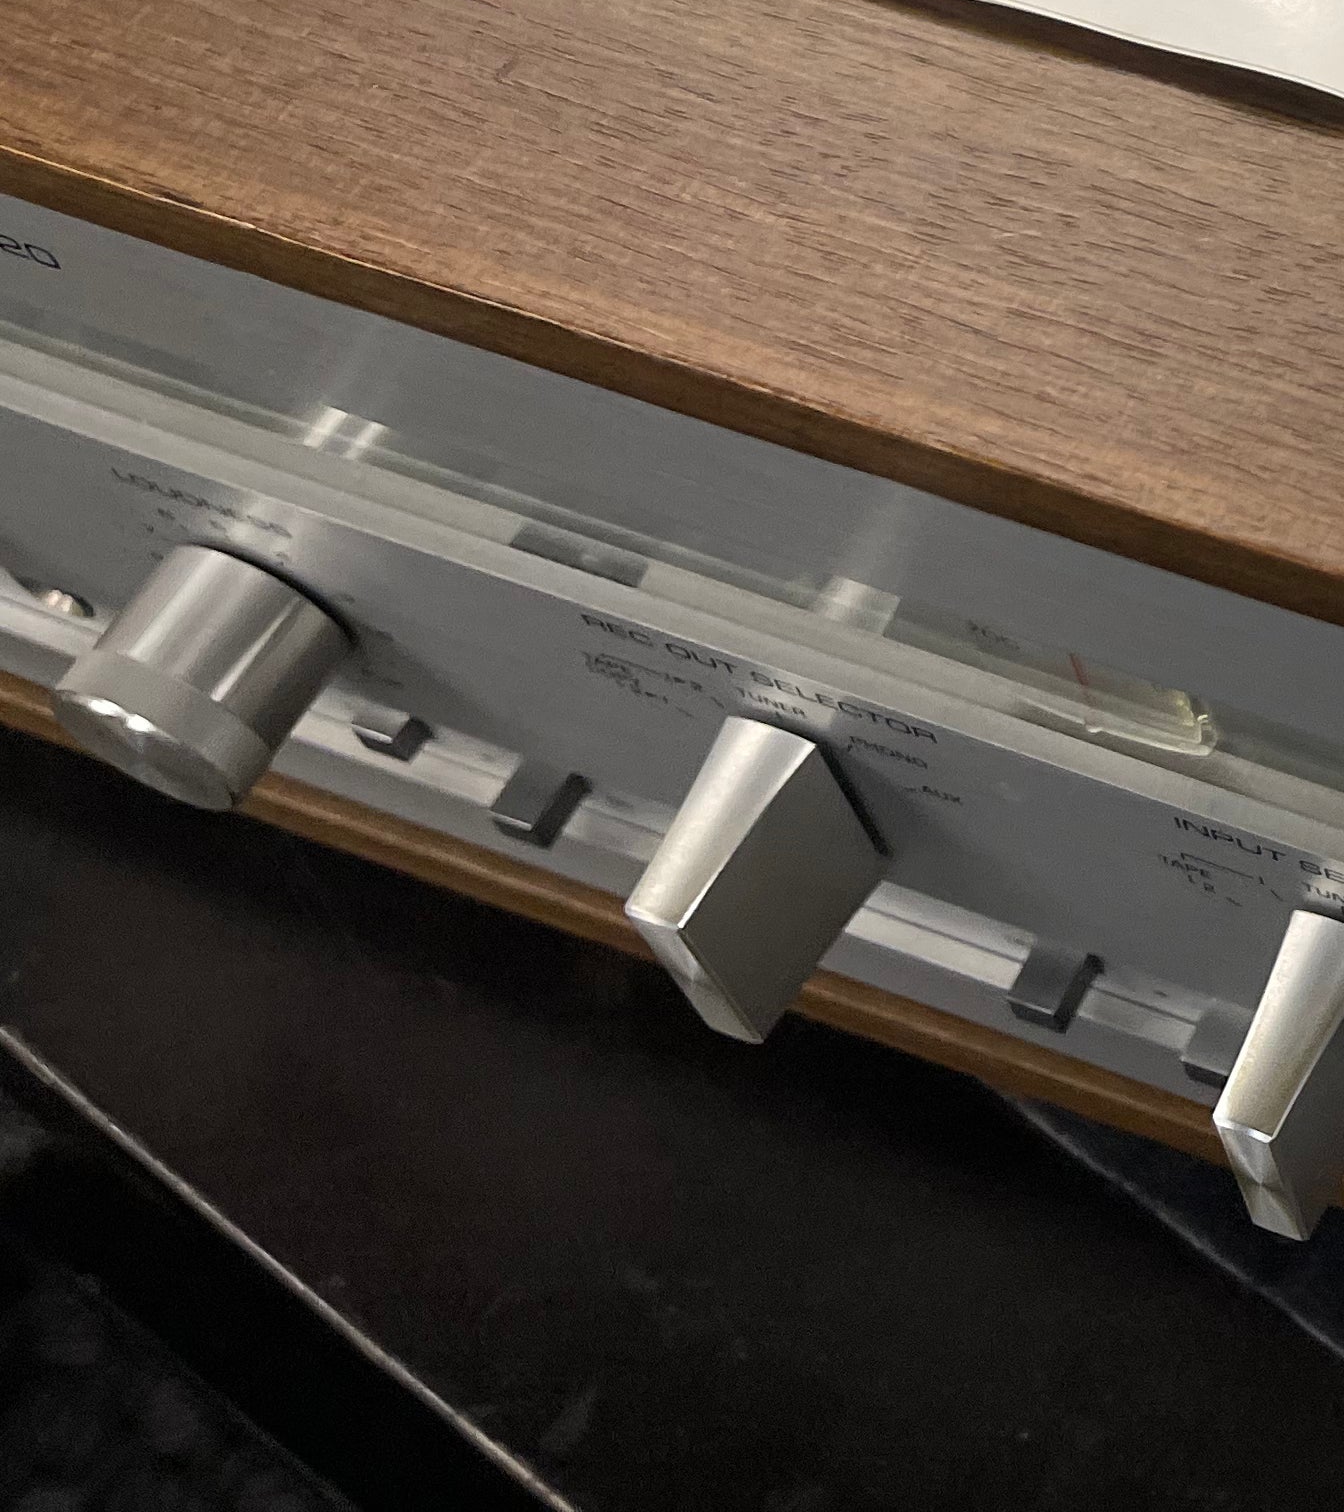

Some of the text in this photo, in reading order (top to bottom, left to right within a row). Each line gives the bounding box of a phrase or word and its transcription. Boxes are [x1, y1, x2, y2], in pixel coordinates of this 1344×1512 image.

[580, 613, 654, 648] REC
[665, 642, 738, 675] OUT
[751, 670, 938, 745] SELECTOR
[1173, 816, 1288, 862] INPUT
[1158, 854, 1212, 881] TAPE
